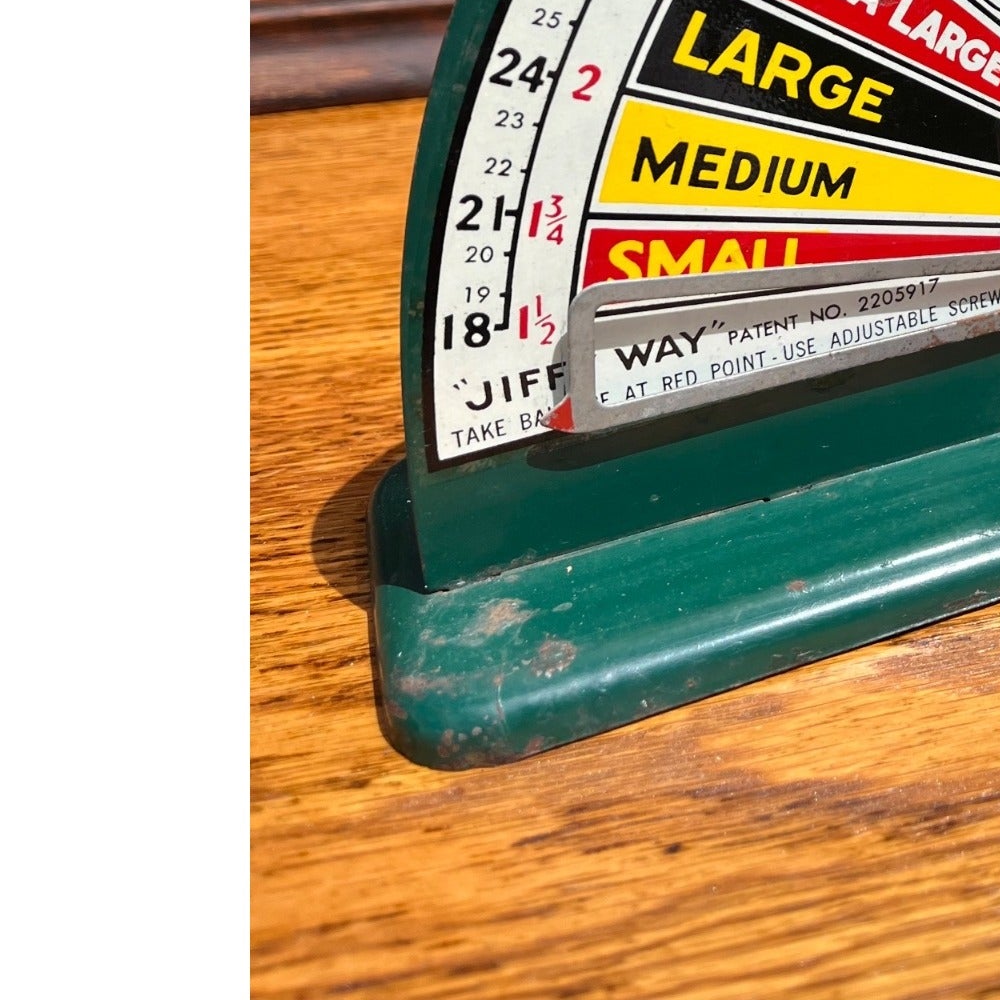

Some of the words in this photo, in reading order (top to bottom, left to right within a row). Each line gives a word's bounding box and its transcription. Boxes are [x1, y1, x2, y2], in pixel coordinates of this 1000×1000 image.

[531, 8, 563, 29] 25
[489, 47, 547, 93] 24
[571, 64, 602, 101] 2
[672, 10, 895, 123] LARGE
[494, 109, 525, 129] 23
[483, 157, 512, 176] 22
[631, 136, 857, 200] MEDIUM
[455, 194, 505, 231] 21
[464, 246, 494, 263] 20
[606, 237, 799, 282] SMALL
[465, 286, 490, 303] 19
[728, 315, 799, 347] PATENT
[810, 303, 848, 325] NO.
[858, 277, 940, 312] 2205917
[443, 312, 491, 350] 18
[451, 418, 507, 448] TAKE
[625, 381, 648, 401] AT
[662, 370, 698, 391] RED
[830, 304, 938, 350] ADJUSTABLE
